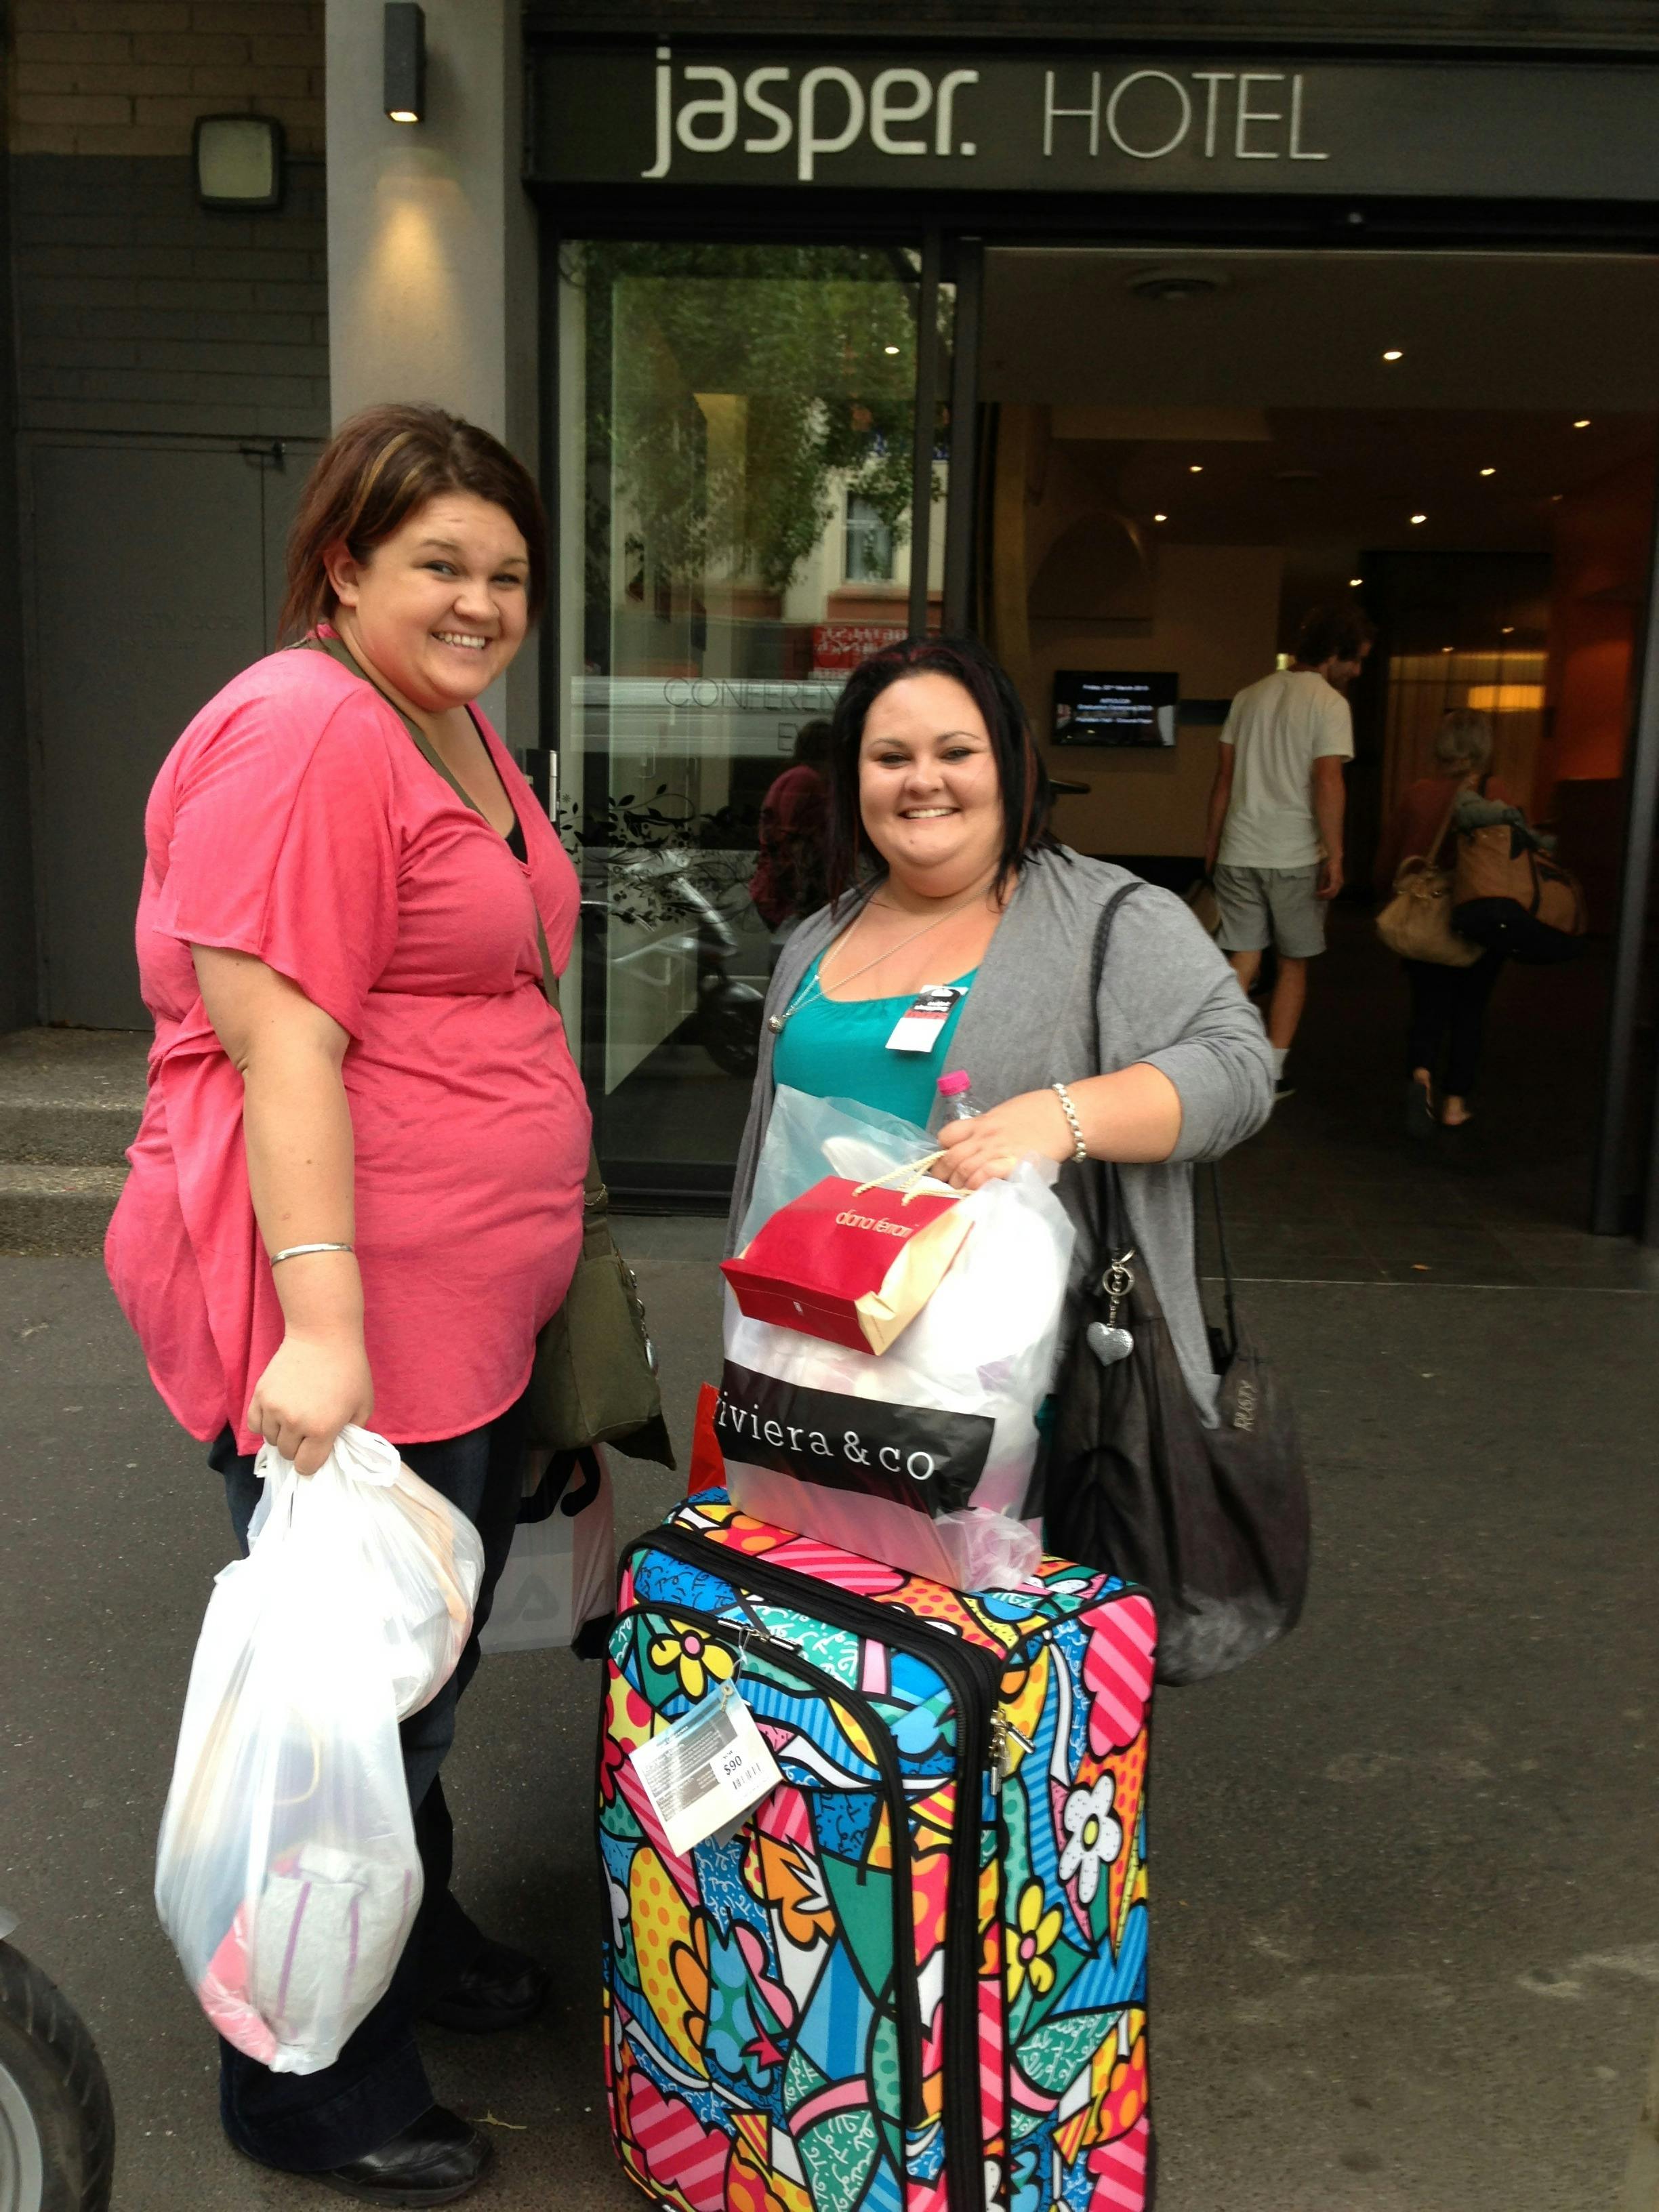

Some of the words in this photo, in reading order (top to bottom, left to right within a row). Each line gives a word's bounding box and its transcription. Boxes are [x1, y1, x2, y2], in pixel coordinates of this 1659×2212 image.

[1043, 70, 1330, 160] HOTEL
[663, 676, 842, 711] CONFEREN
[723, 1755, 743, 1776] $90
